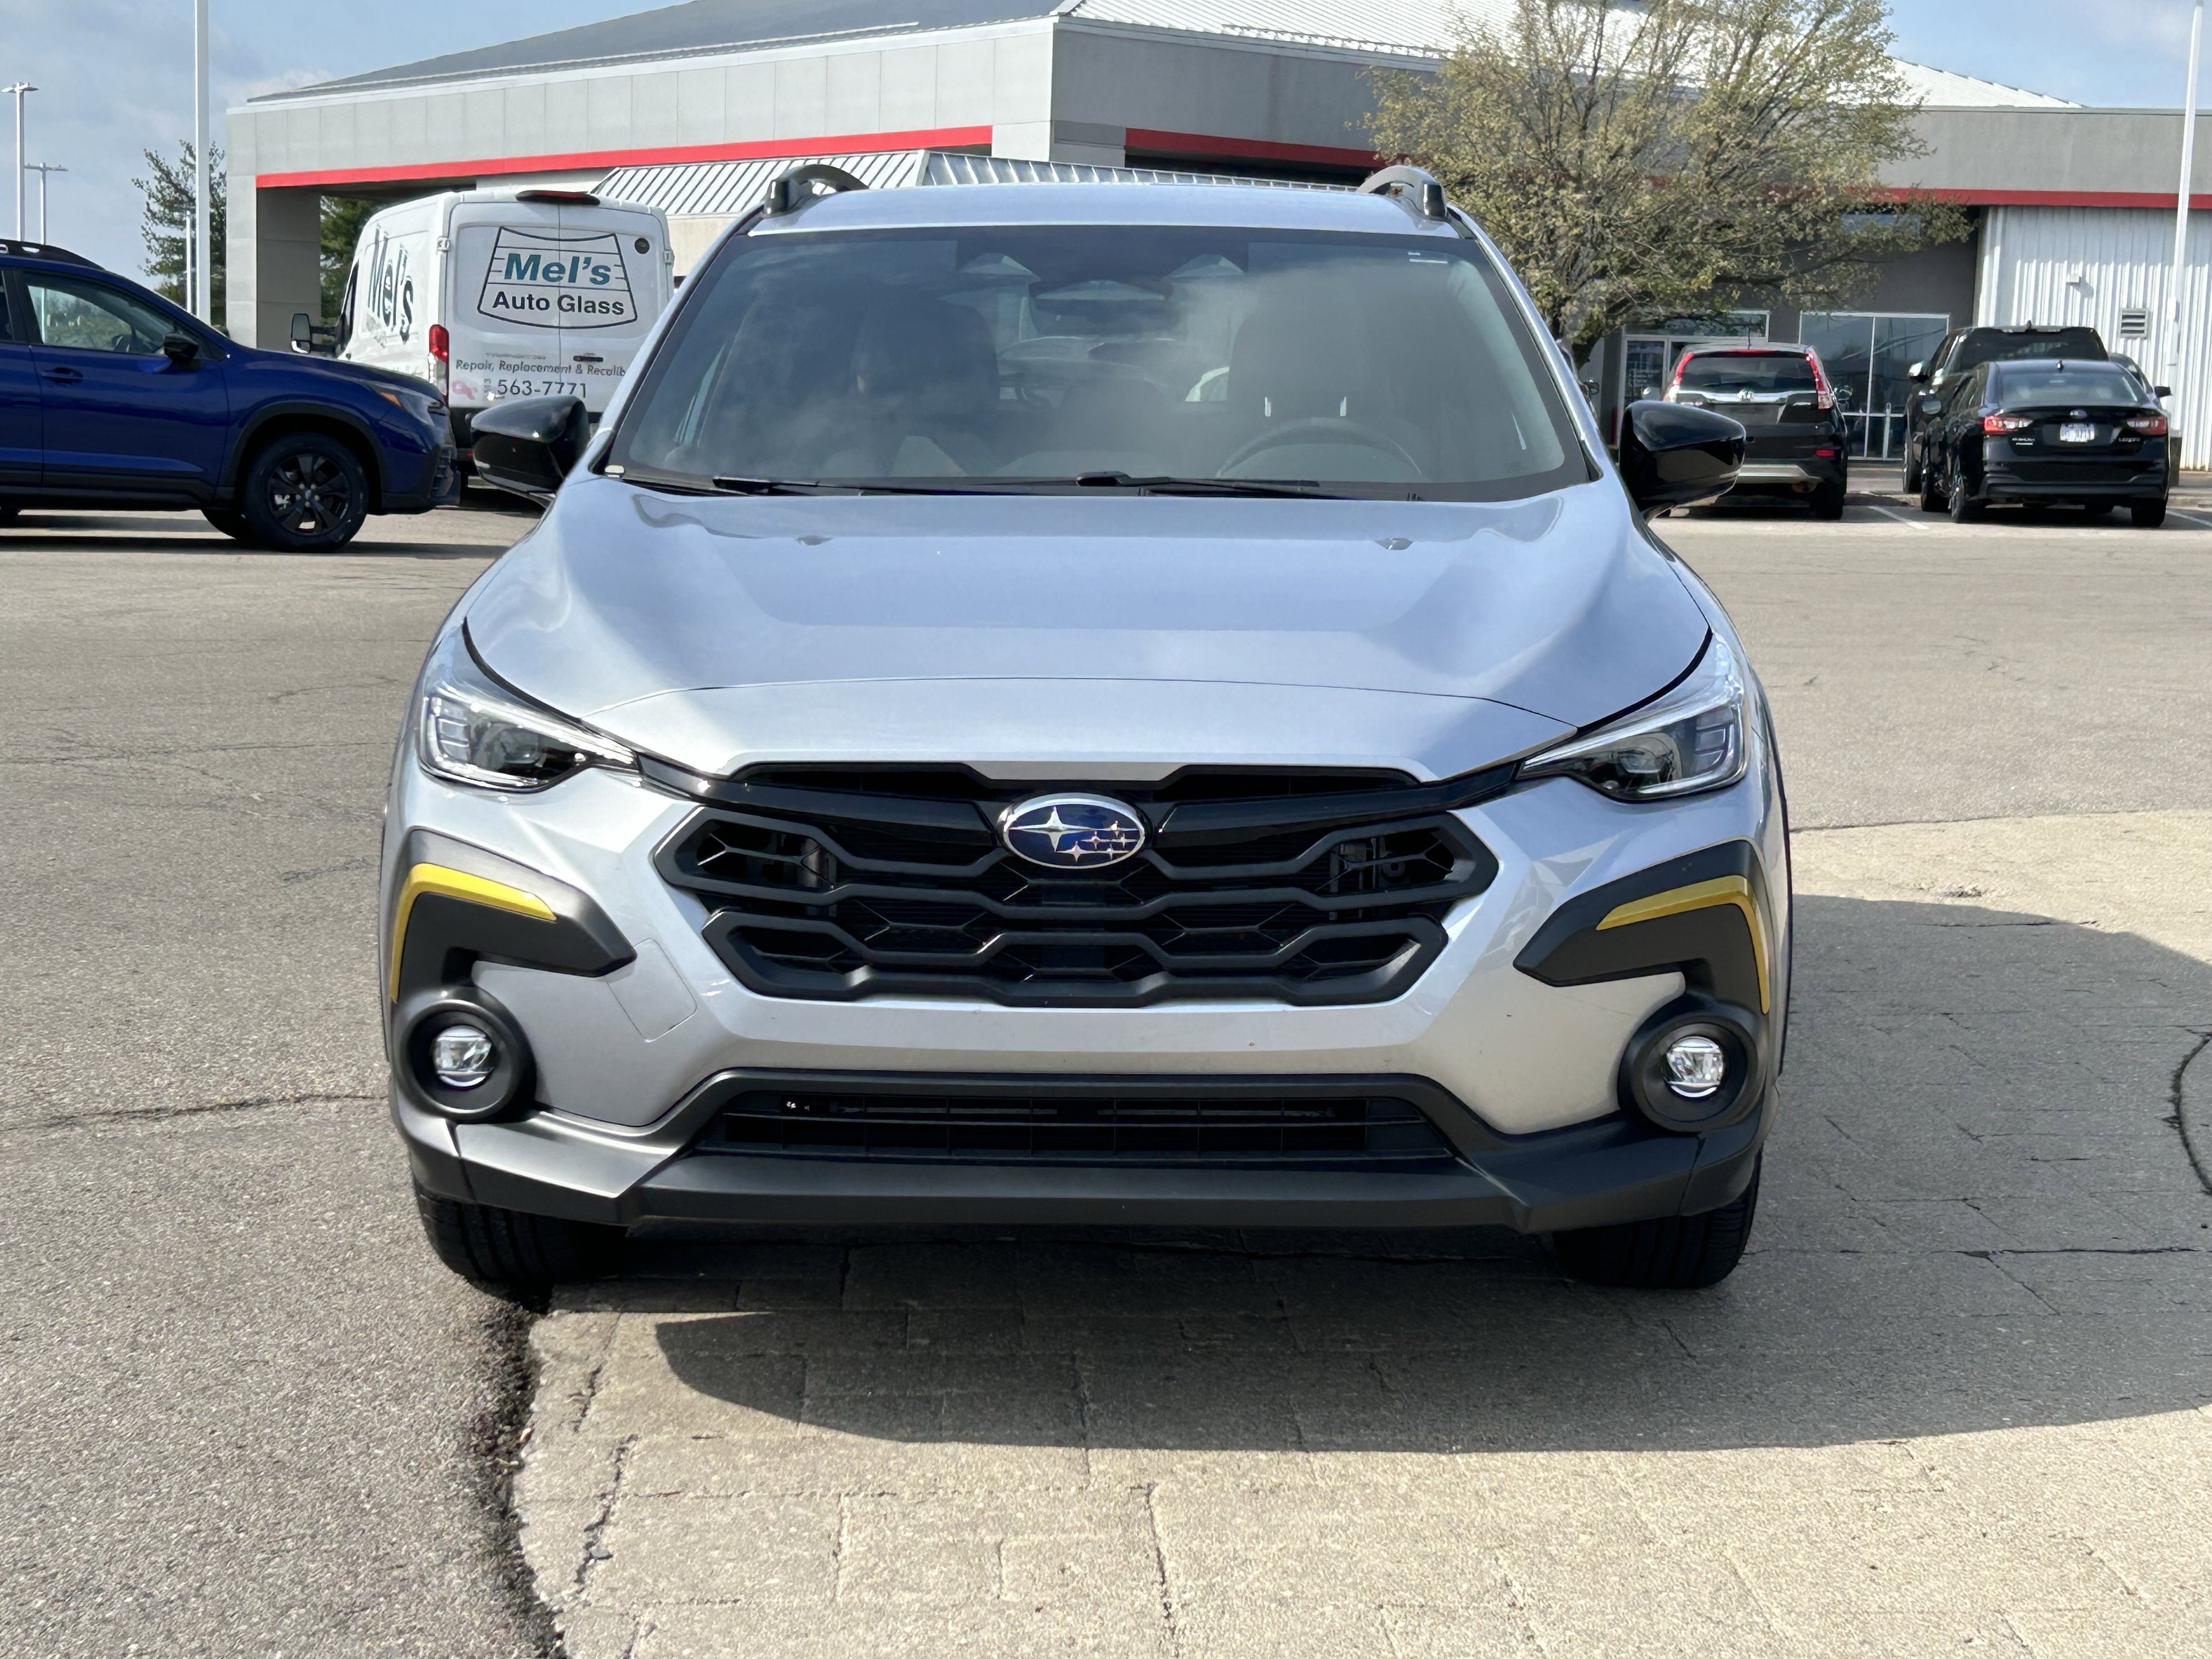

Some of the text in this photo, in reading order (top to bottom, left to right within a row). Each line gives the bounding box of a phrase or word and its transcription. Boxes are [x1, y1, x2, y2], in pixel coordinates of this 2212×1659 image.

[504, 253, 611, 285] Mel's
[492, 291, 624, 315] Auto Glass
[456, 359, 494, 373] Repair,
[499, 360, 572, 373] Replacement
[575, 364, 583, 374] &
[497, 379, 586, 398] 563-7771
